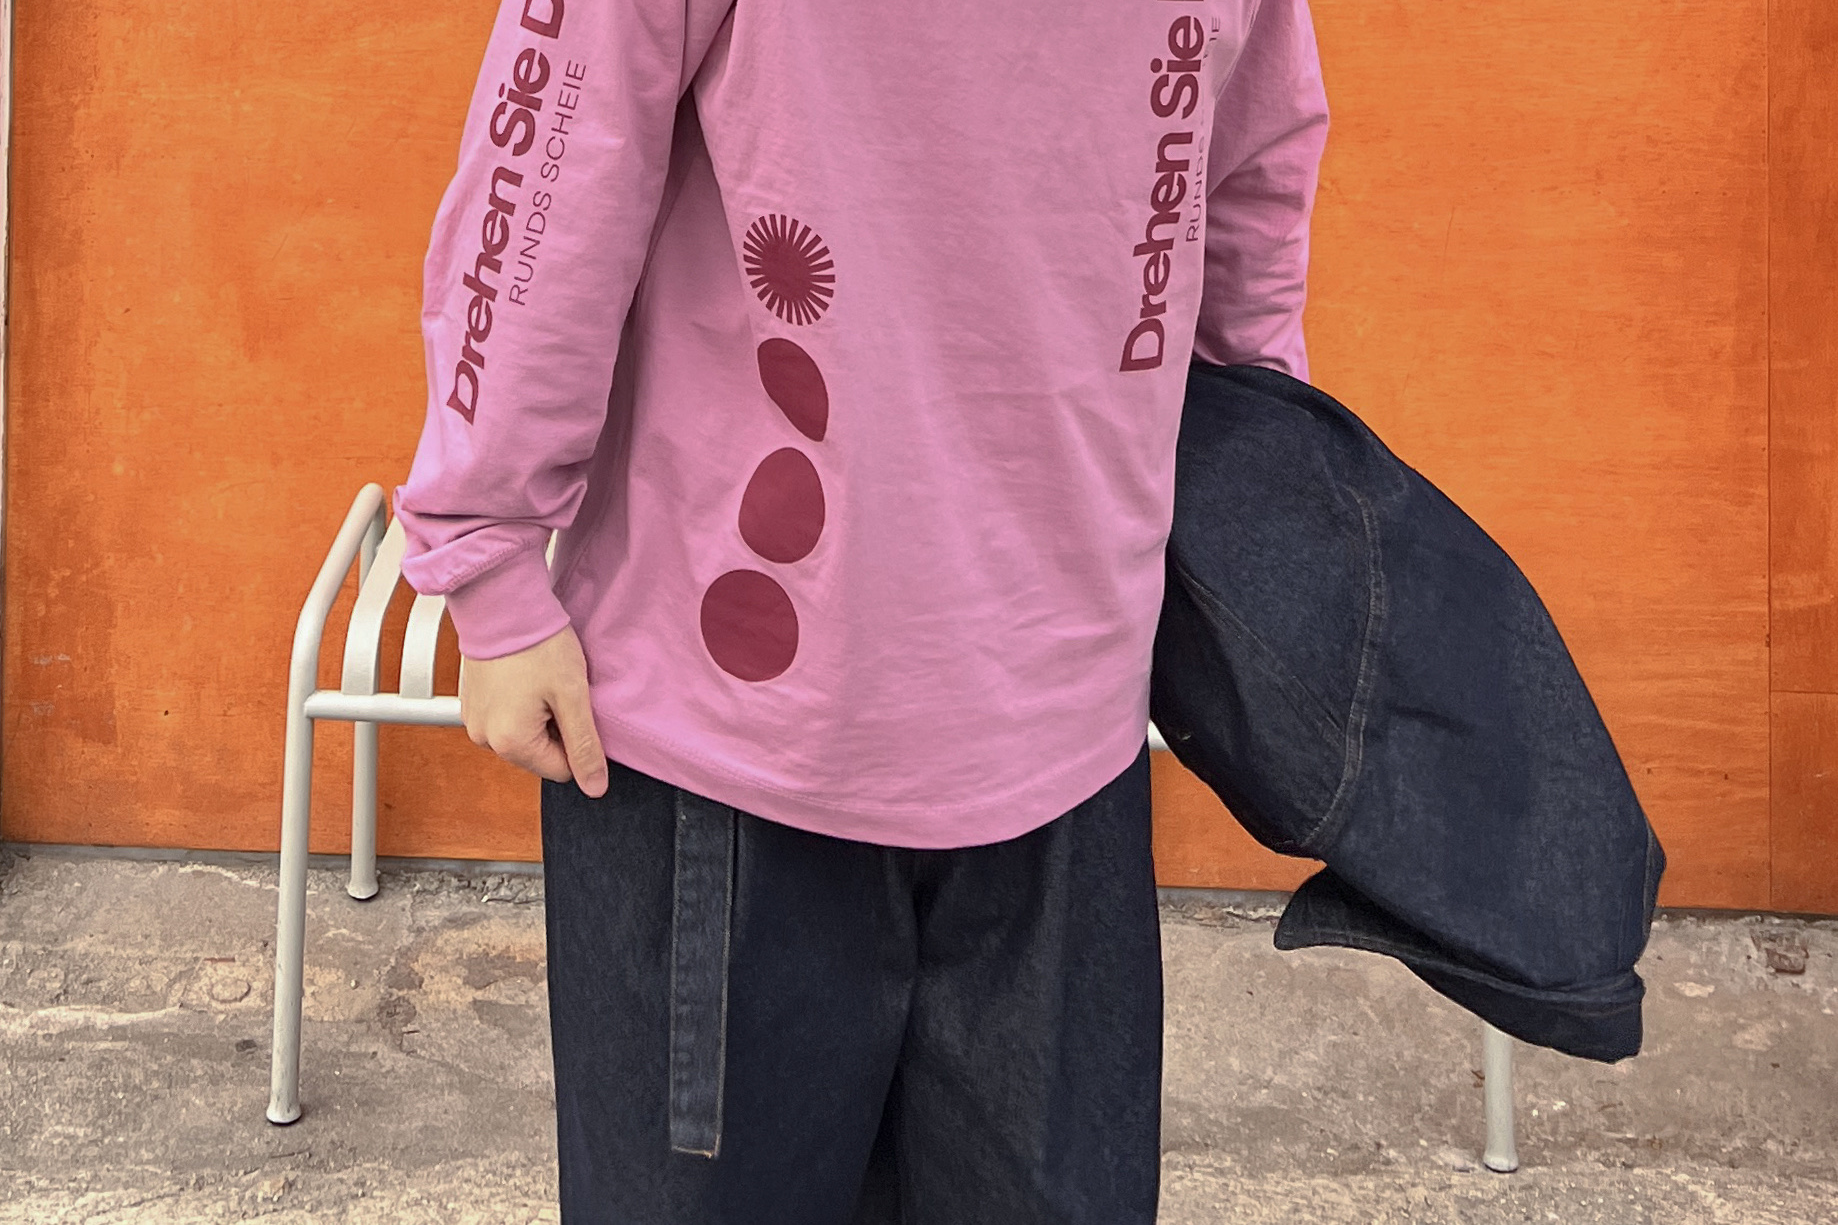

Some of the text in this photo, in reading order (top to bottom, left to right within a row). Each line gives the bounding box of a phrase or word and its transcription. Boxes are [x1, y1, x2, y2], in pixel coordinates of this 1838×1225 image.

[509, 60, 586, 305] RUNDS SCHEIE
[1150, 16, 1204, 119] Sie
[447, 167, 523, 425] Drehen
[490, 48, 550, 156] Sie
[1119, 132, 1193, 372] Drehen
